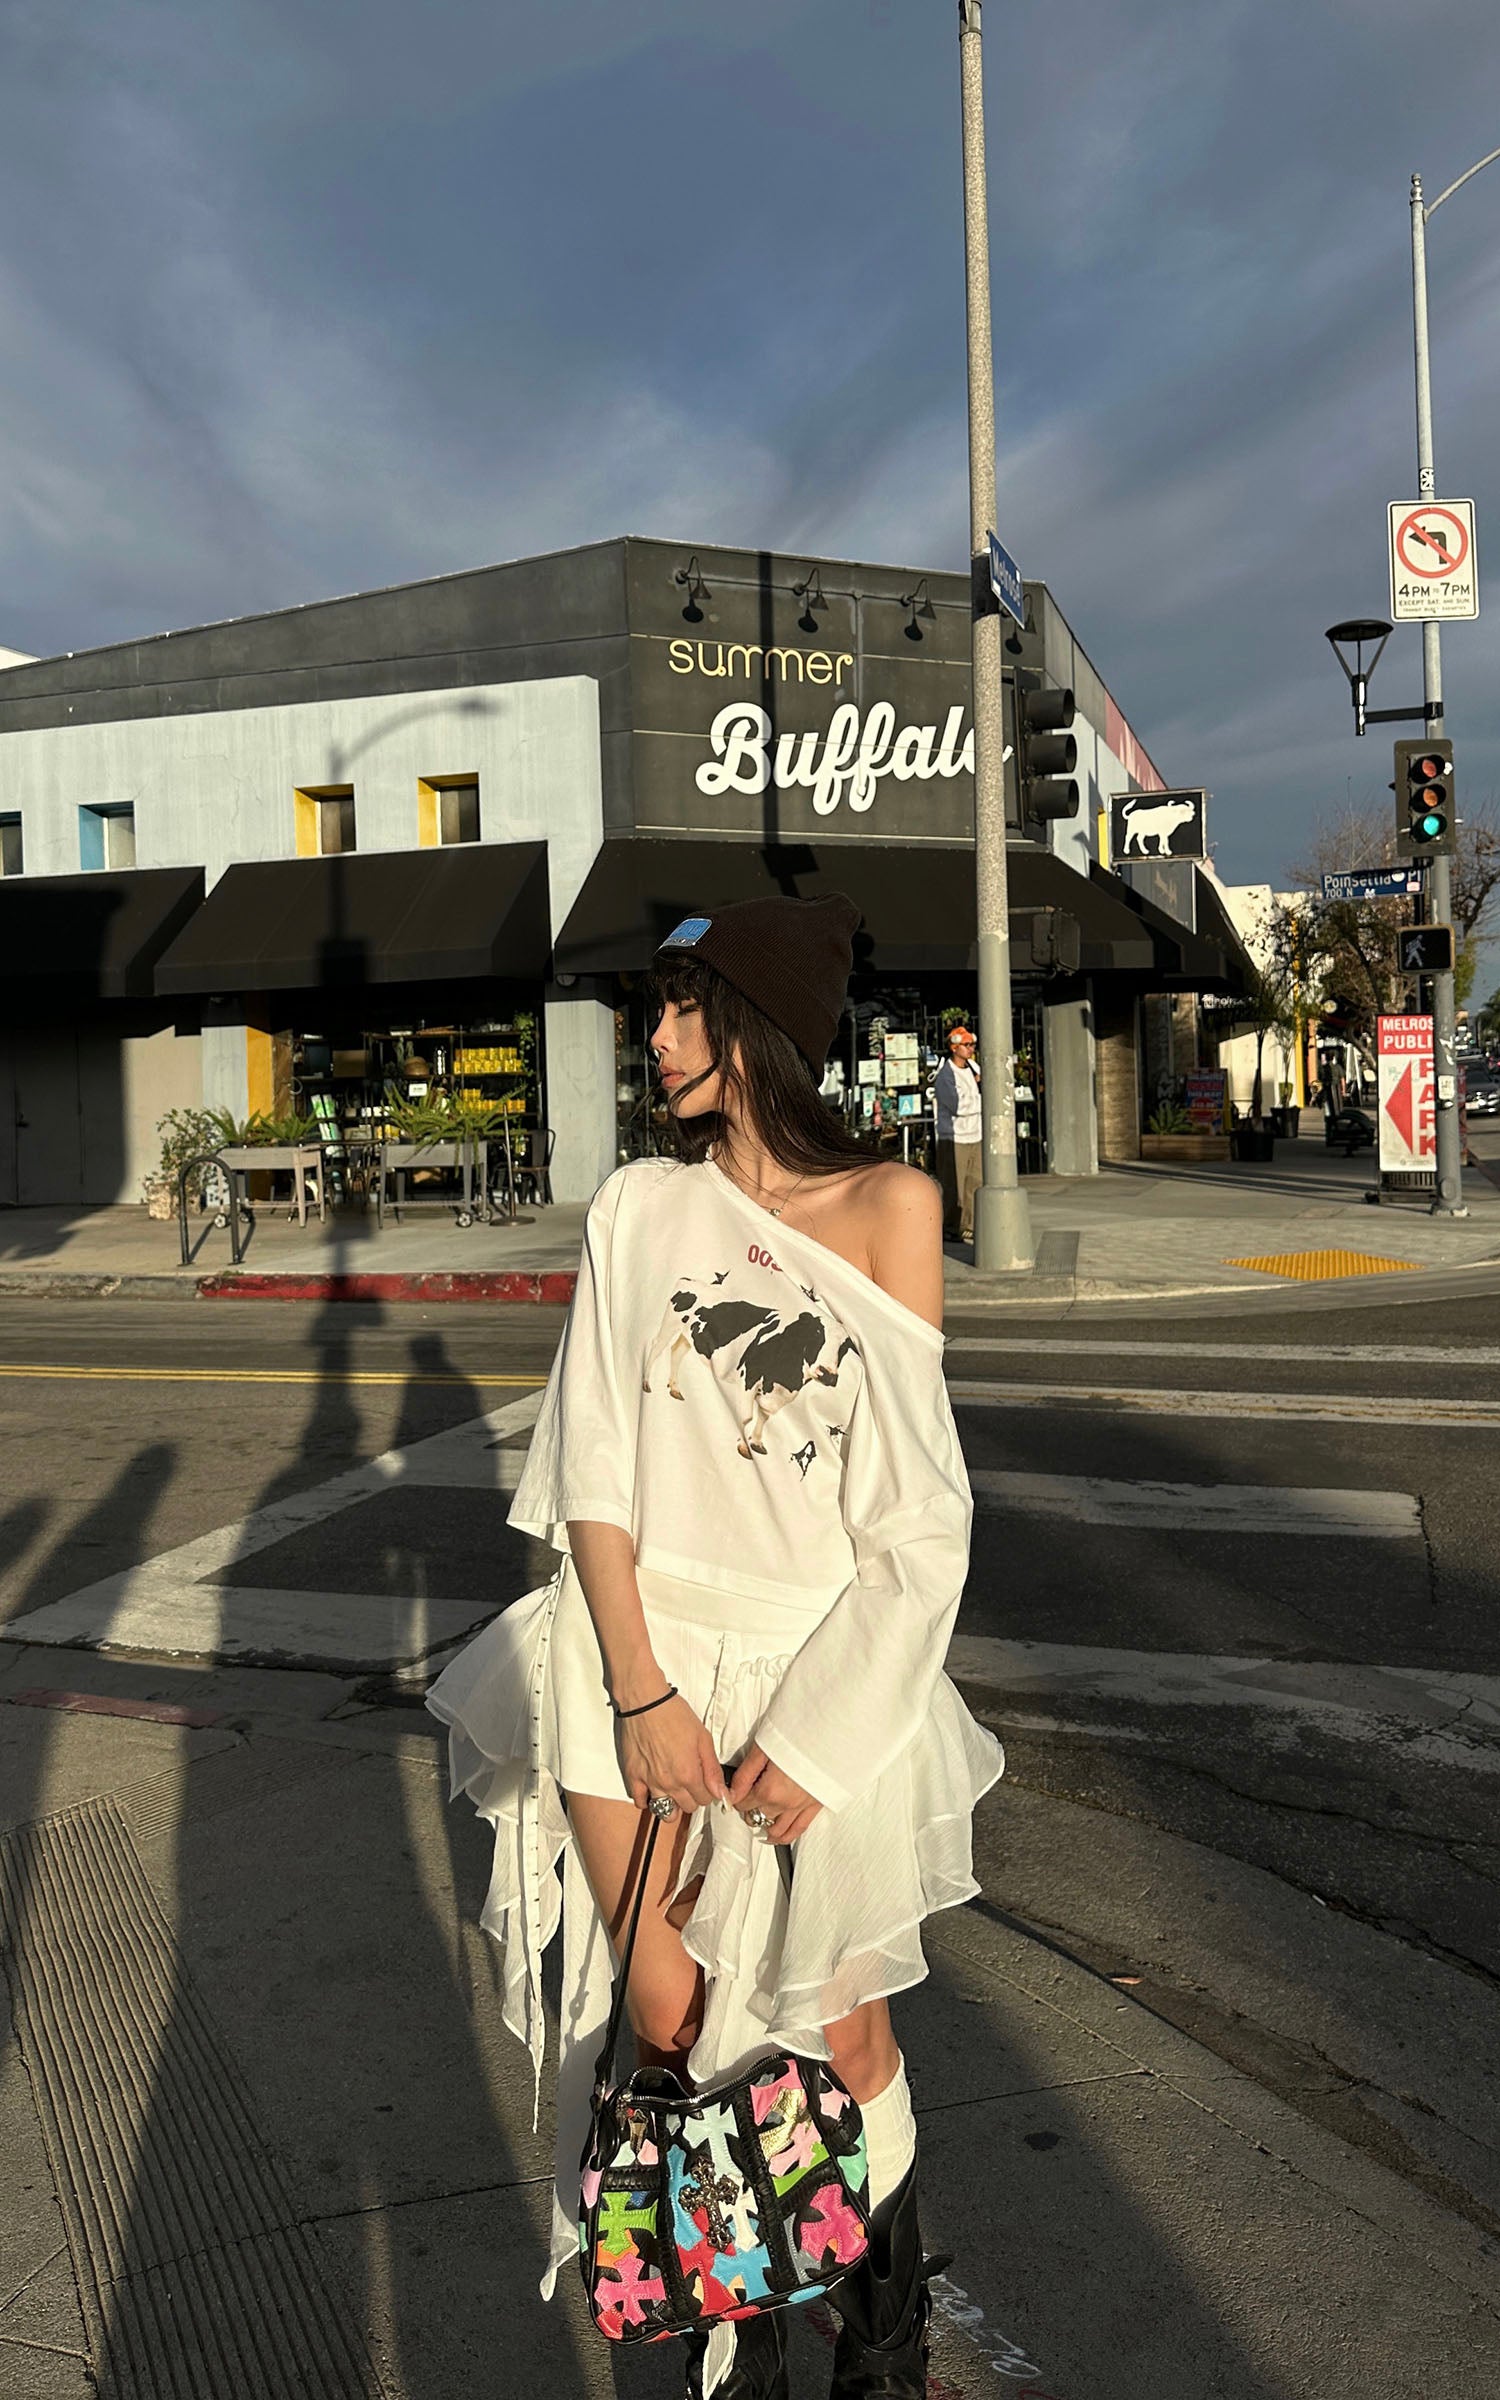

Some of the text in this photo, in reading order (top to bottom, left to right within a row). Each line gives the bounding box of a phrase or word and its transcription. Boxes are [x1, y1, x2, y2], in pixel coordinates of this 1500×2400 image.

[668, 639, 854, 686] summer
[1325, 887, 1354, 898] 700 N
